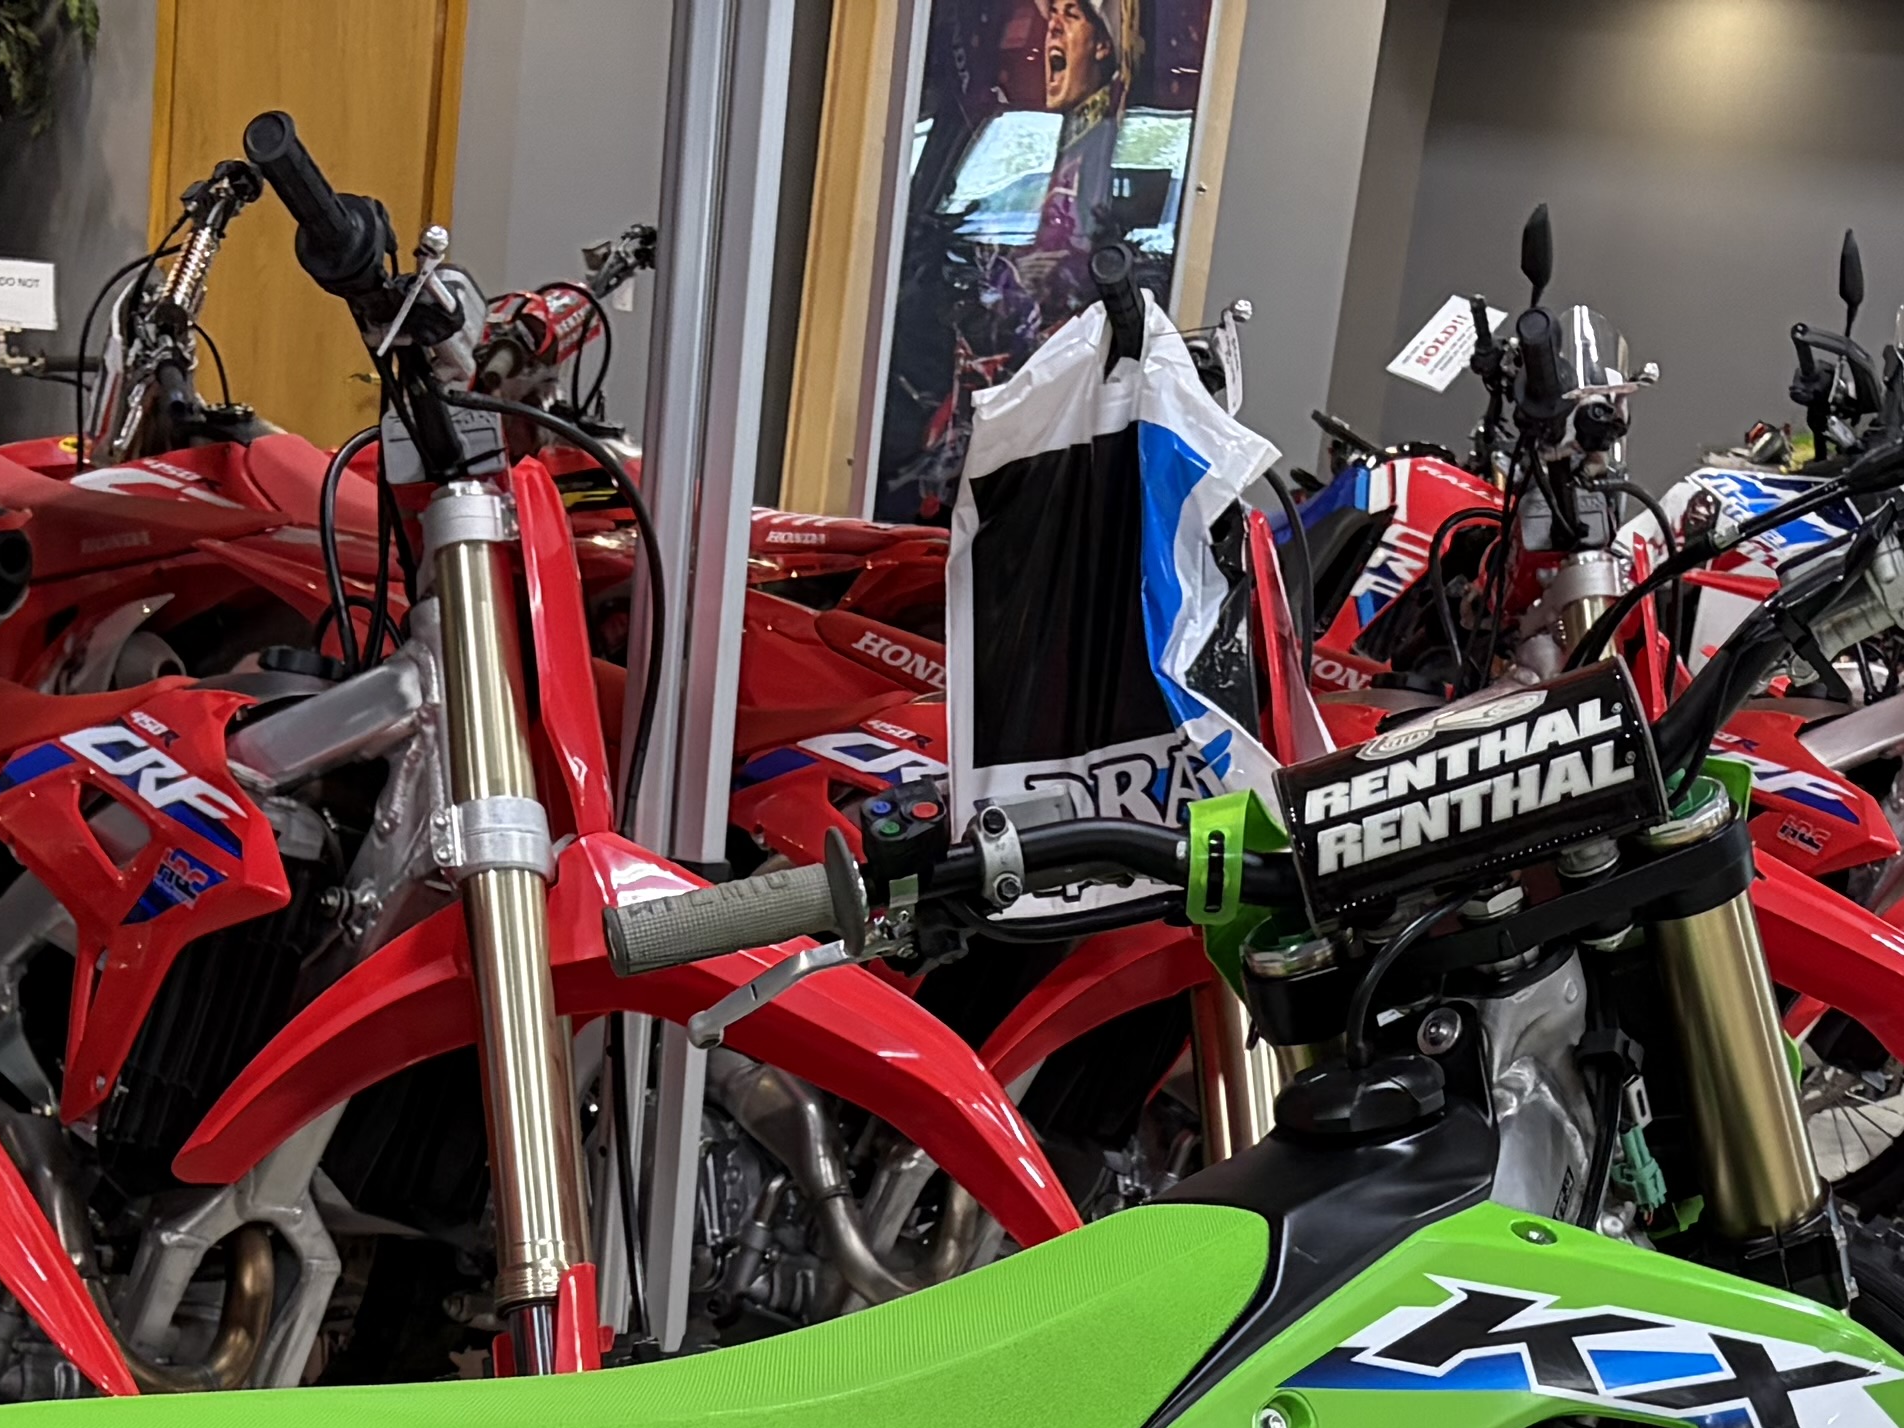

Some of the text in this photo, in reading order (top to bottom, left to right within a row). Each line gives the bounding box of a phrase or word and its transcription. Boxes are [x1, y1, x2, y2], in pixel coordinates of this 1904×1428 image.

[851, 630, 946, 690] HON
[60, 715, 249, 820] CRF
[797, 731, 949, 784] CR
[1304, 697, 1622, 825] RENTHAL
[1317, 740, 1636, 877] RENTHAL
